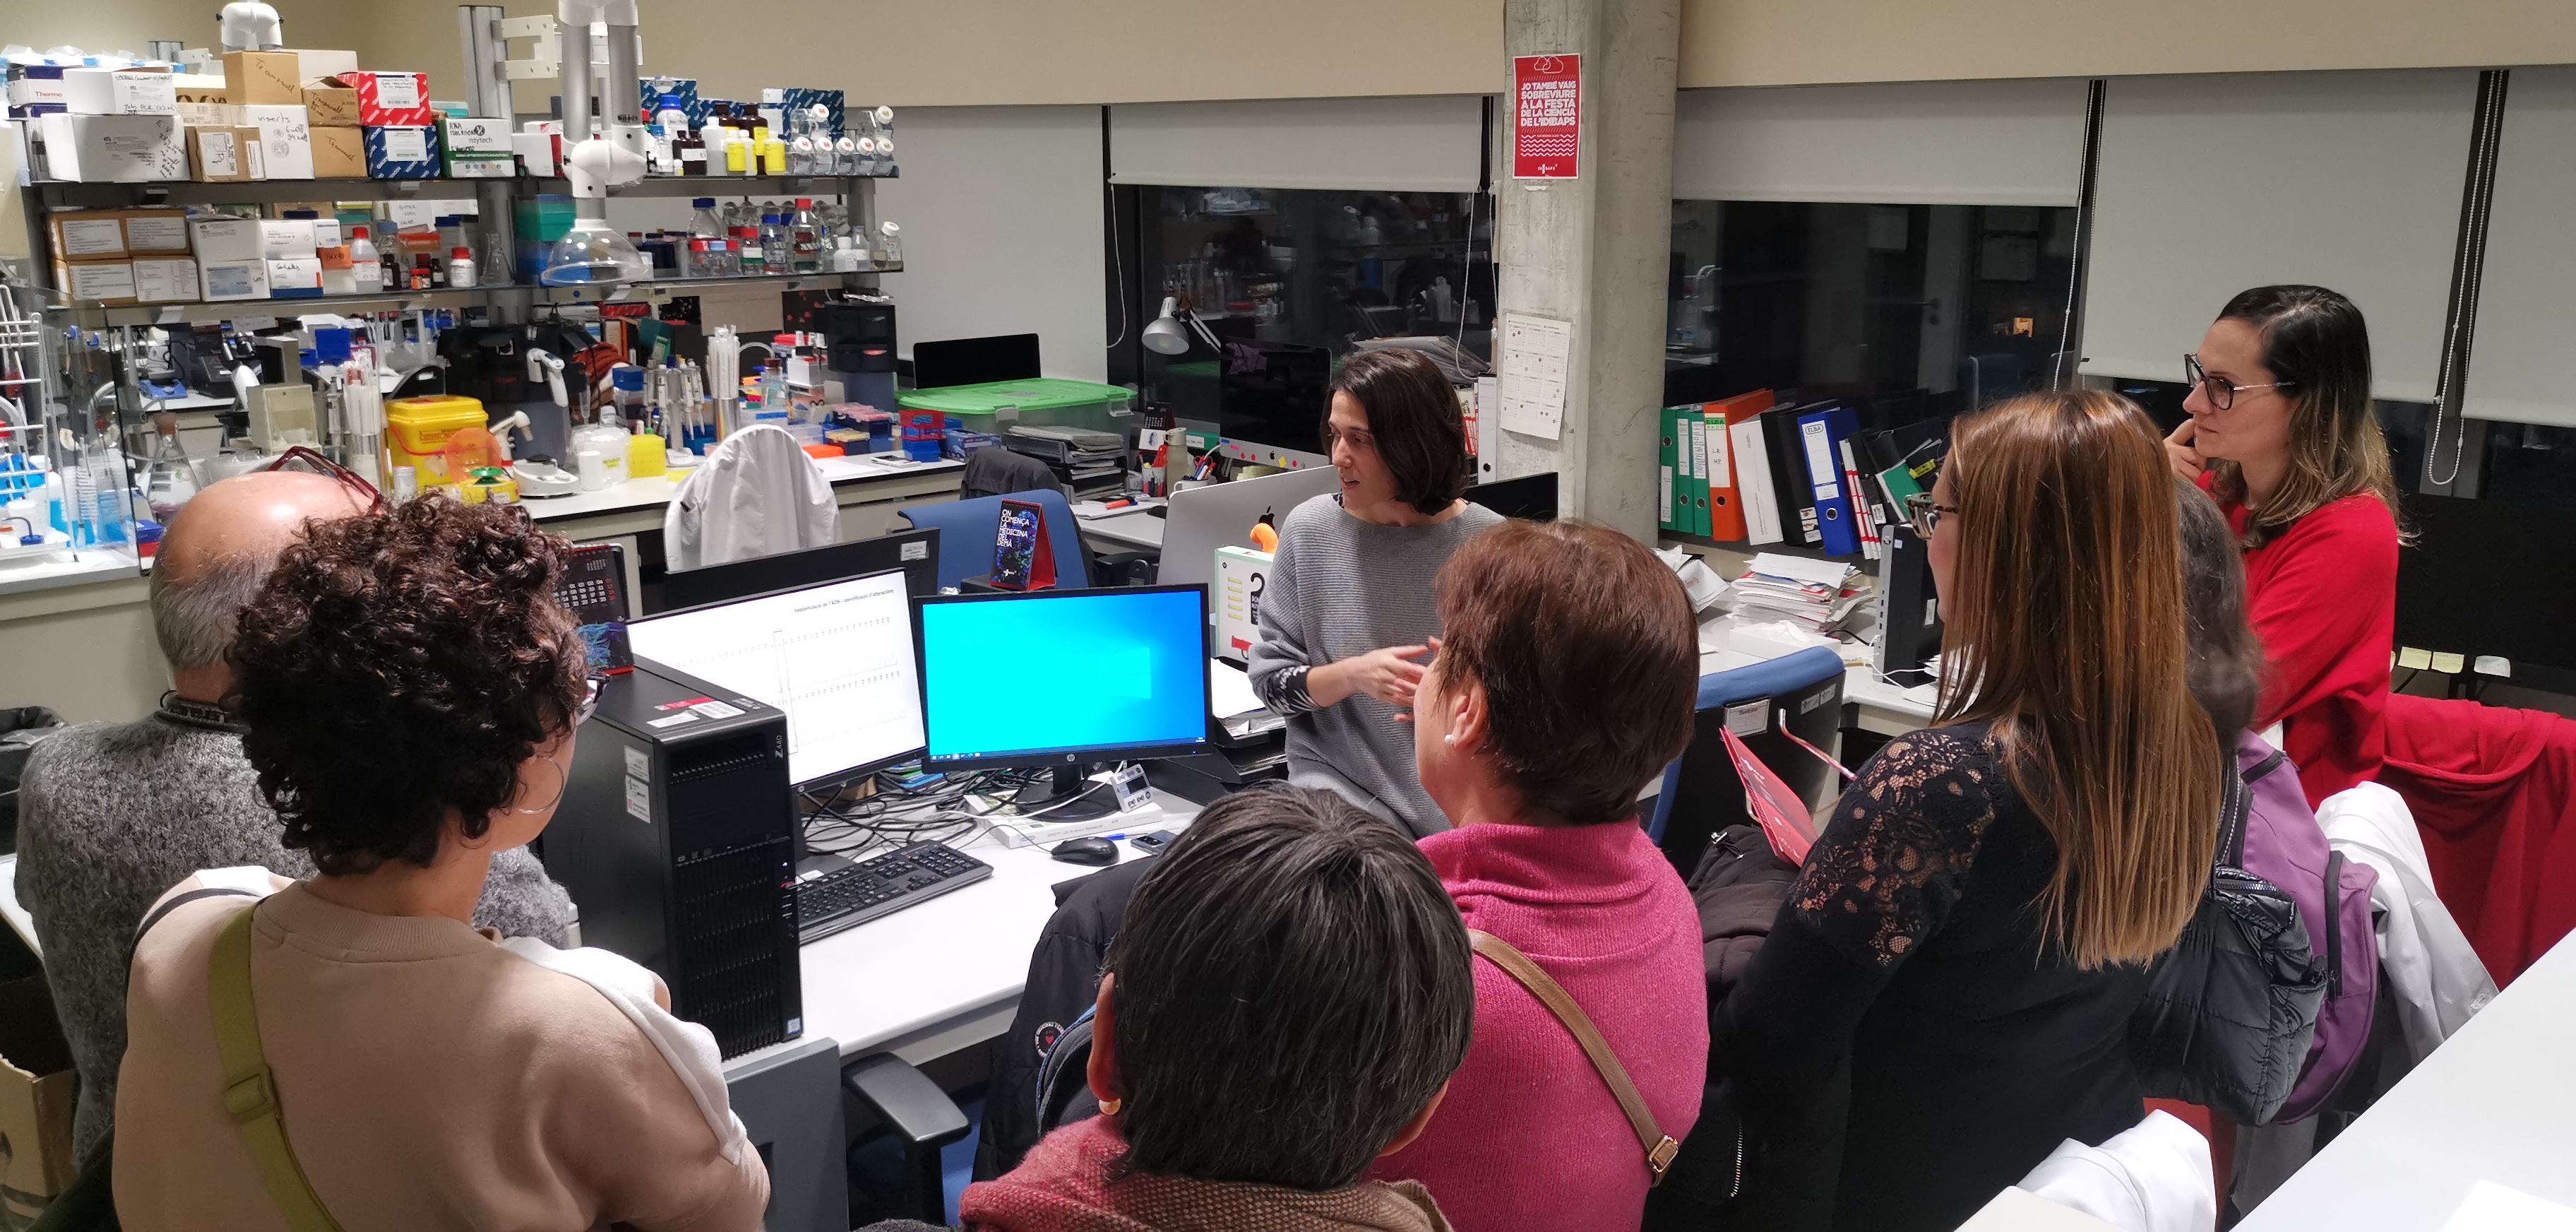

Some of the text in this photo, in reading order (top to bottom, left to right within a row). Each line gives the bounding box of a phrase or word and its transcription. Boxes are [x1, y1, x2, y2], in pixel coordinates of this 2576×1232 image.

[1558, 81, 1576, 89] VAIG
[1521, 90, 1576, 100] SOBREVIURE
[1521, 98, 1576, 109] A LA FESTA
[1521, 109, 1532, 117] DE
[1521, 117, 1576, 126] DE L'IDIBAPS
[1001, 516, 1030, 526] COMENÇA
[999, 528, 1028, 538] MEDICINA
[775, 735, 783, 759] Z440
